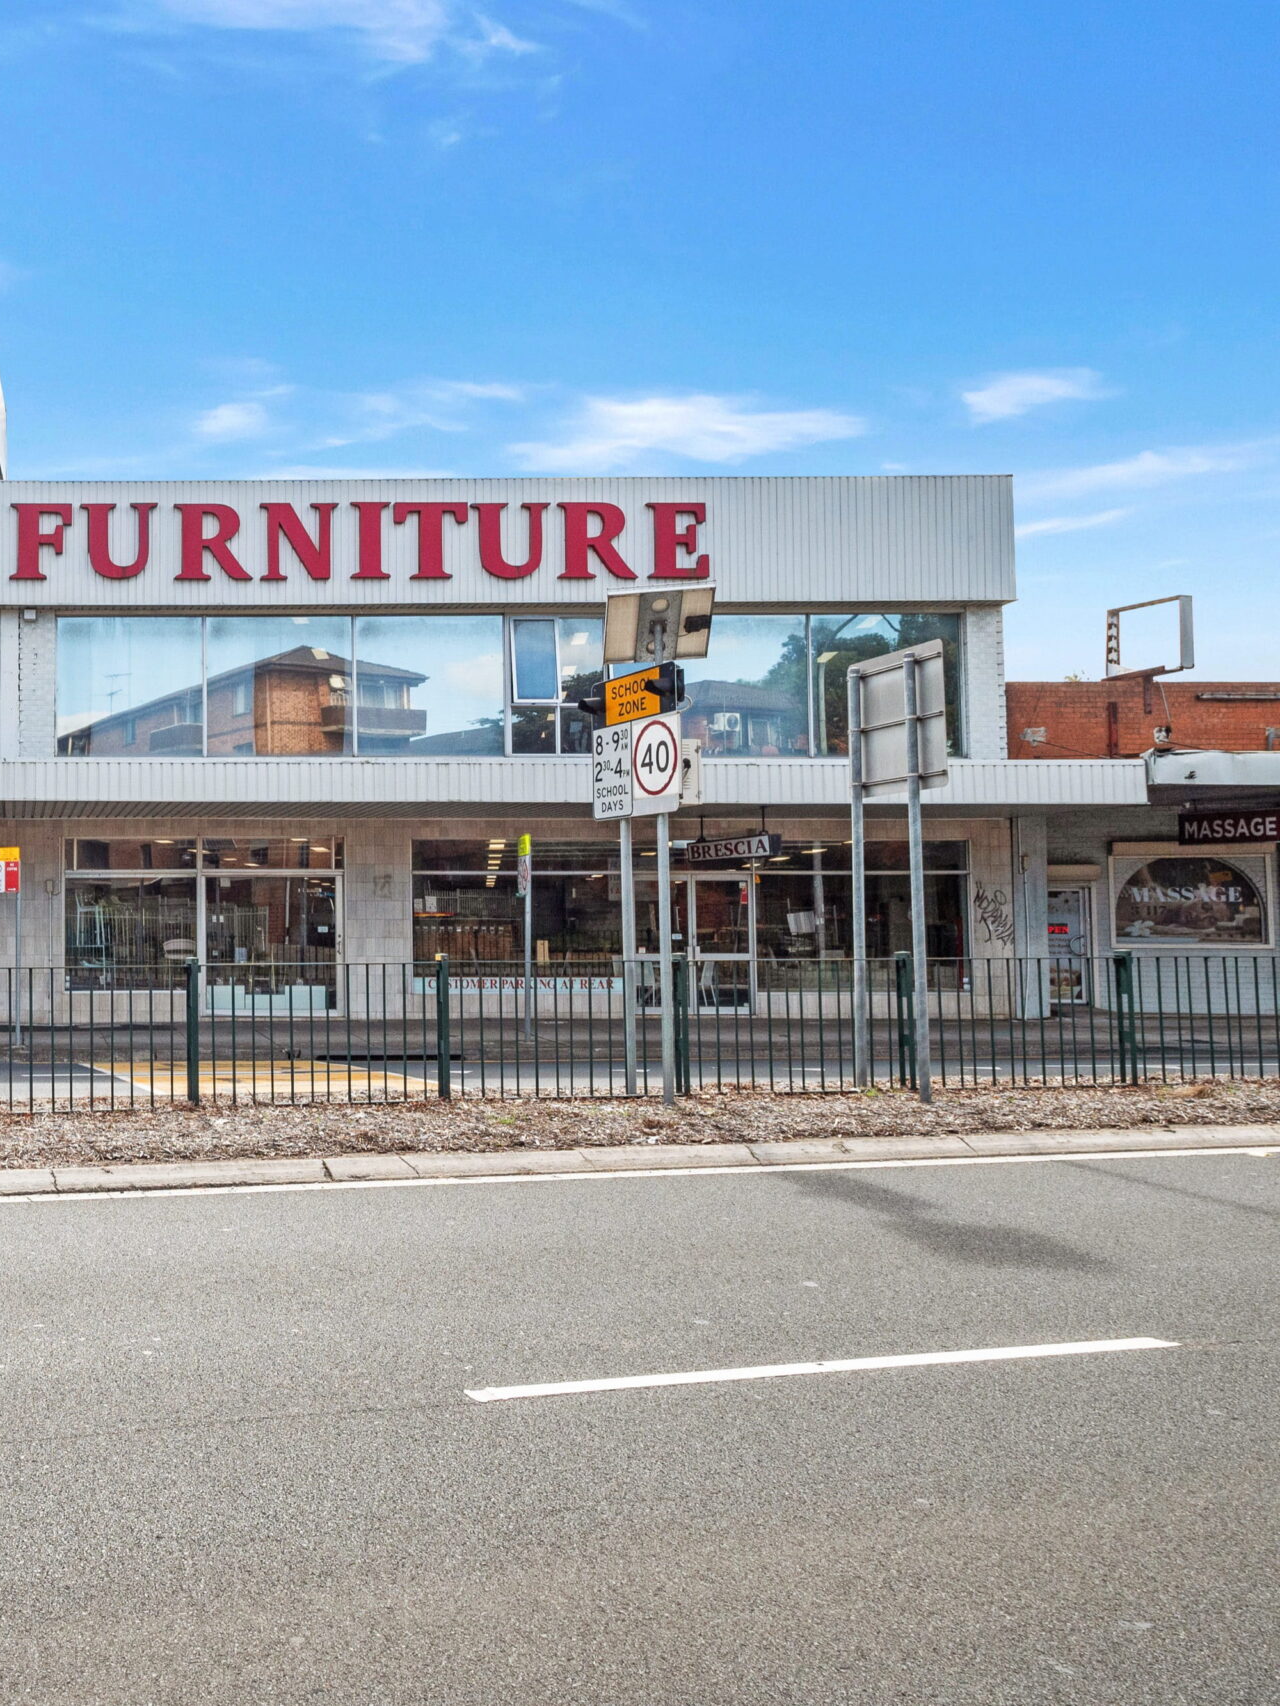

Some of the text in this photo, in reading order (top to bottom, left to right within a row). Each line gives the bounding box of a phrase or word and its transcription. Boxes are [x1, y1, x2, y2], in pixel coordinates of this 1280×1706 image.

[8, 501, 711, 581] FURNITURE
[611, 677, 650, 700] SCHOO
[618, 697, 647, 716] ZONE
[640, 740, 670, 775] 40
[596, 784, 629, 799] SCHOOL
[601, 800, 624, 813] DAYS
[1184, 817, 1277, 839] MASSAGE
[690, 838, 768, 859] BRESCIA
[1131, 886, 1243, 903] MASSAGE
[1048, 925, 1070, 934] PEN
[428, 978, 498, 989] CSTOMER
[502, 979, 555, 989] PARNG
